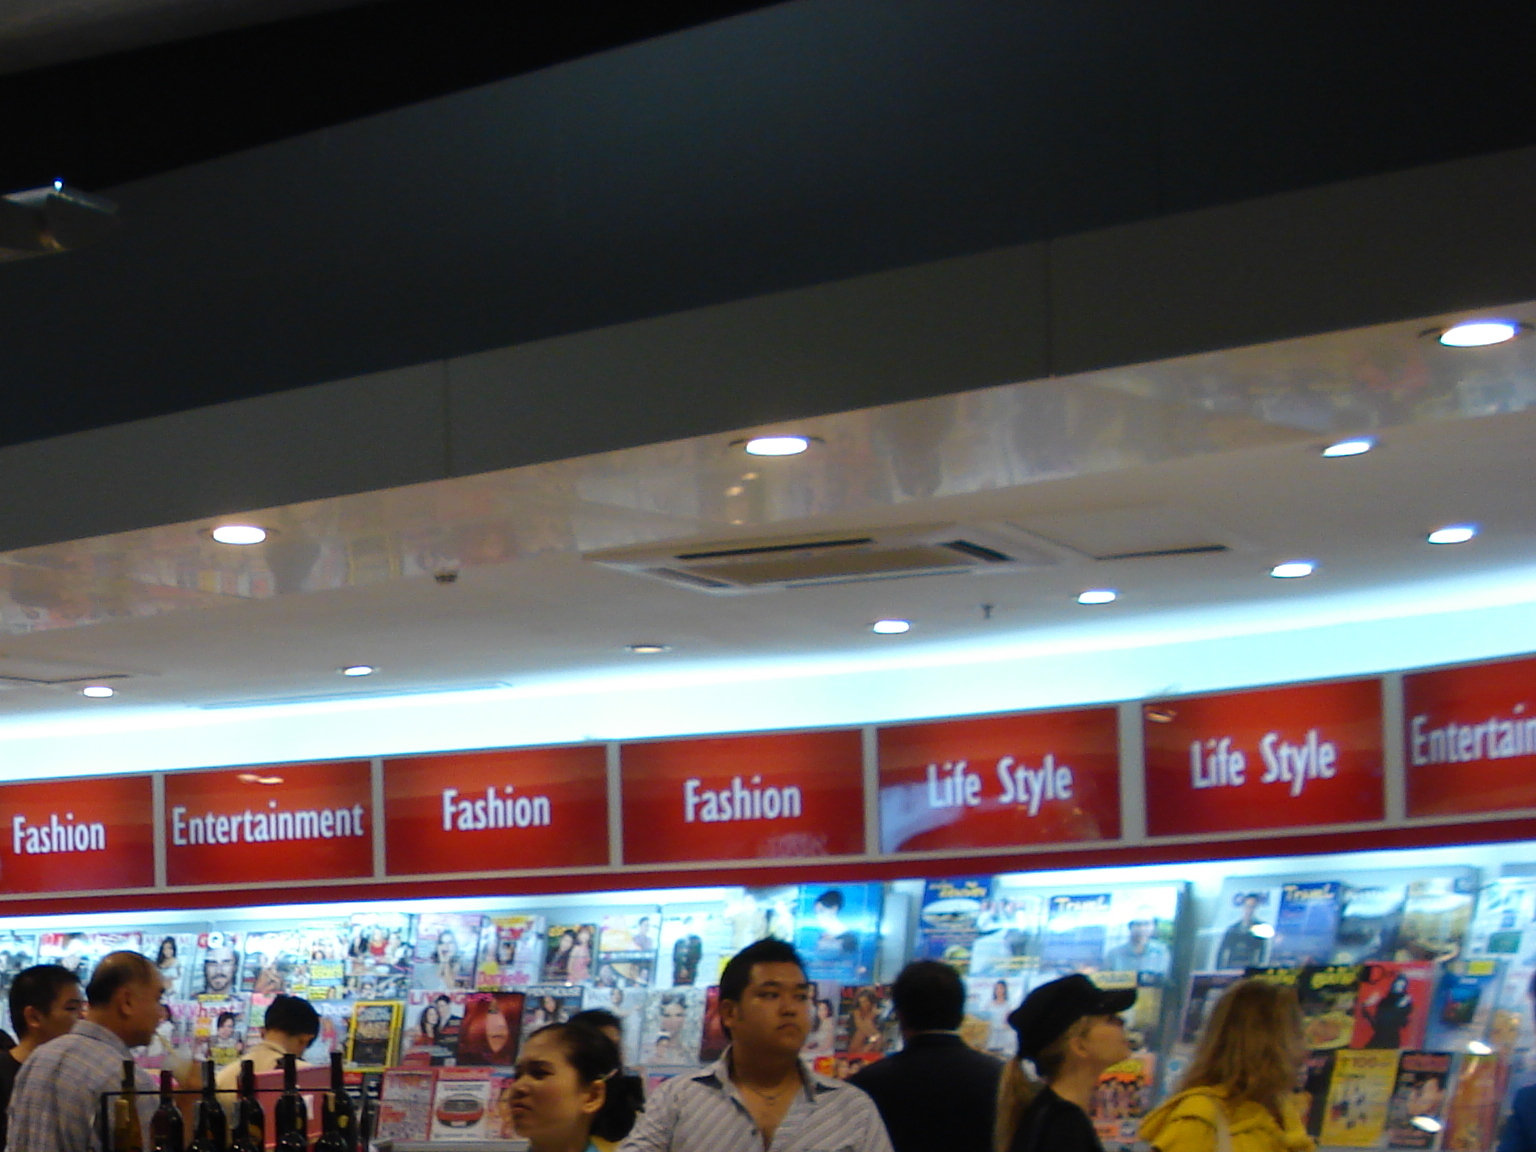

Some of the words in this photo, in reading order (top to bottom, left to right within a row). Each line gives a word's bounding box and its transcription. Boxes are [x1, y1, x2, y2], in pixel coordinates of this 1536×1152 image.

[927, 760, 982, 809] Life
[996, 753, 1074, 817] Style
[1191, 738, 1246, 789] Life
[1259, 729, 1337, 797] Style
[441, 785, 551, 831] Fashion
[684, 775, 802, 823] Fashion
[12, 813, 106, 854] Fashion
[172, 800, 364, 846] Entertainment
[197, 931, 224, 949] GQ
